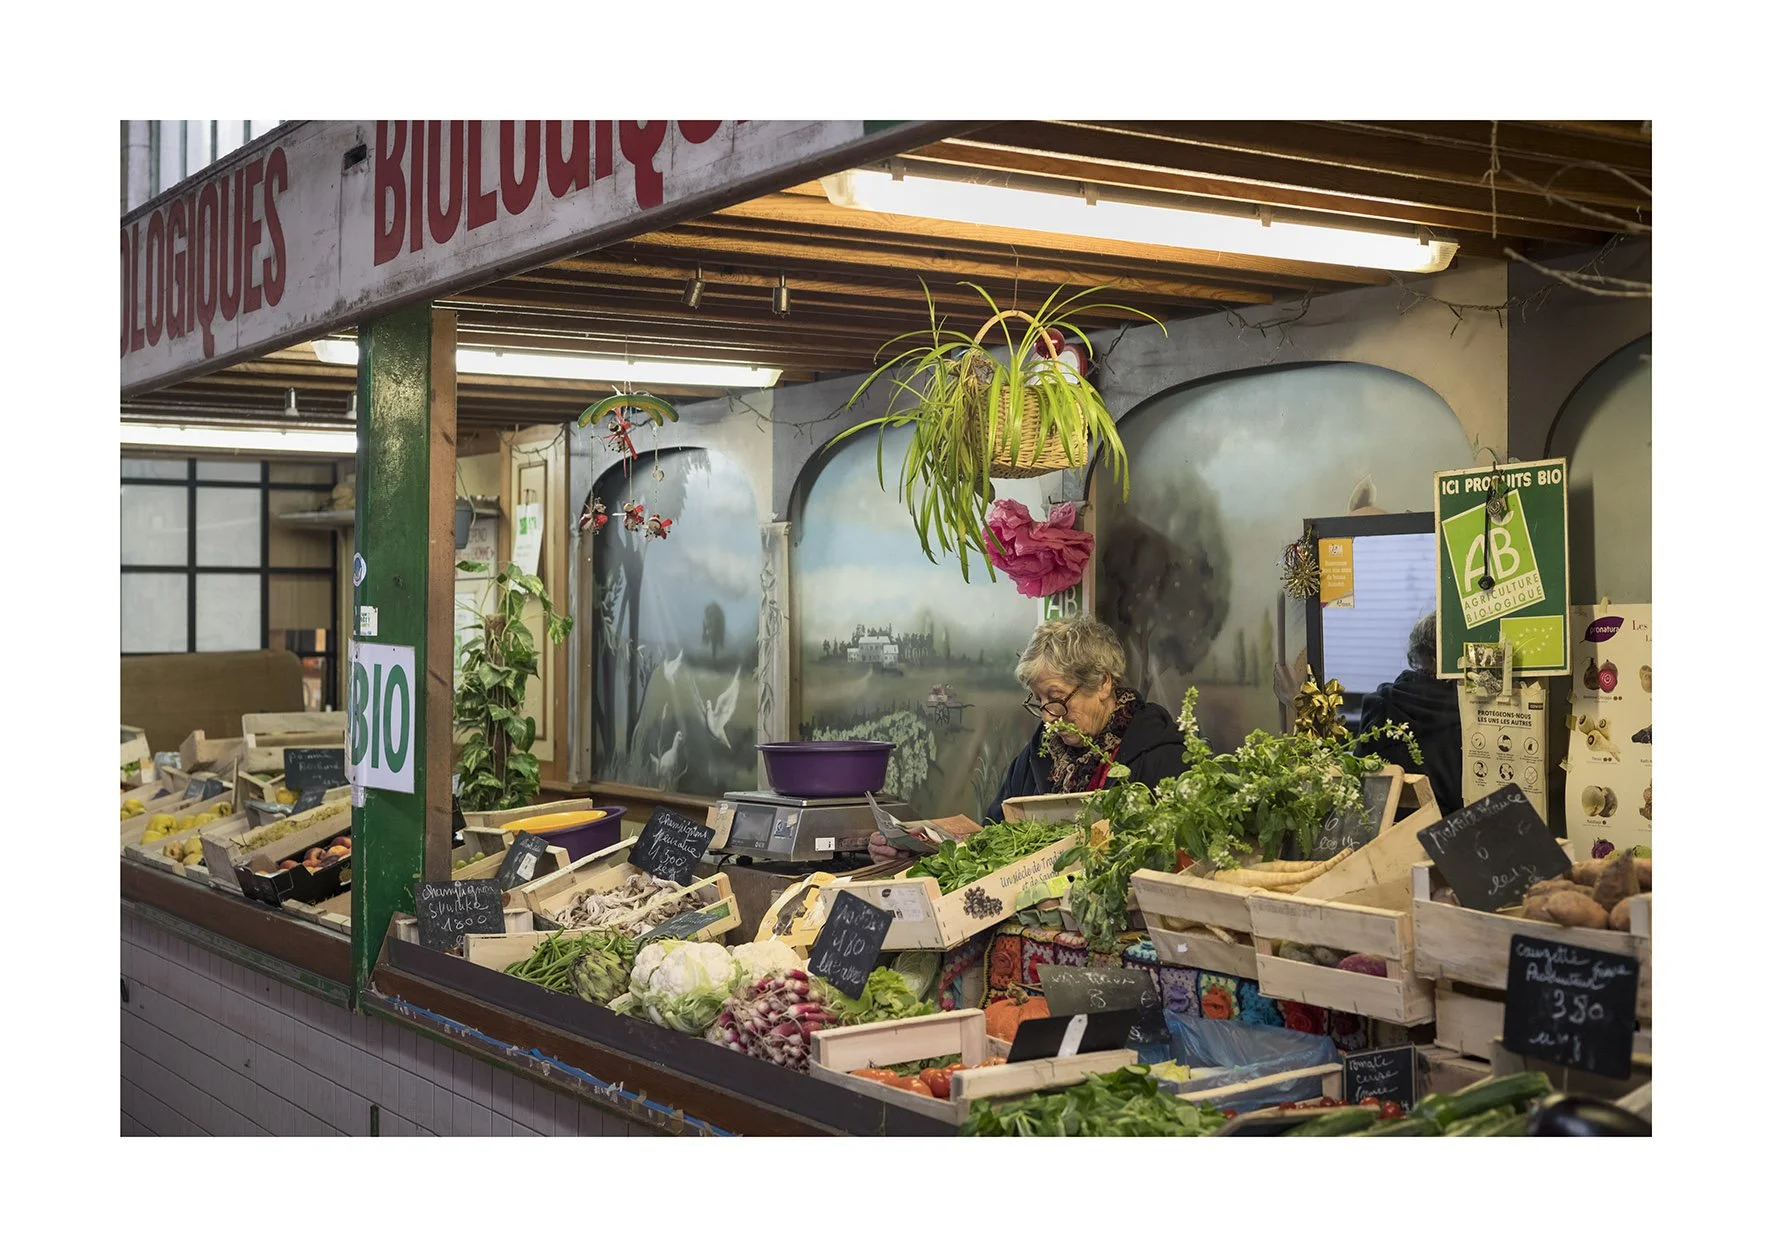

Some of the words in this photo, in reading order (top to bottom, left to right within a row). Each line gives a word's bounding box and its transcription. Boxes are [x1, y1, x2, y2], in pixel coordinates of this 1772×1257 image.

[1442, 479, 1460, 496] ICI
[1537, 468, 1563, 486] BIO
[1464, 526, 1521, 593] AB
[1463, 572, 1541, 612] AGRICULTURE
[1466, 588, 1544, 623] BIOLOGIQUE
[1589, 624, 1621, 634] pronatura
[1632, 619, 1649, 631] Les
[351, 661, 411, 774] BIO
[1511, 718, 1532, 727] AUTRES
